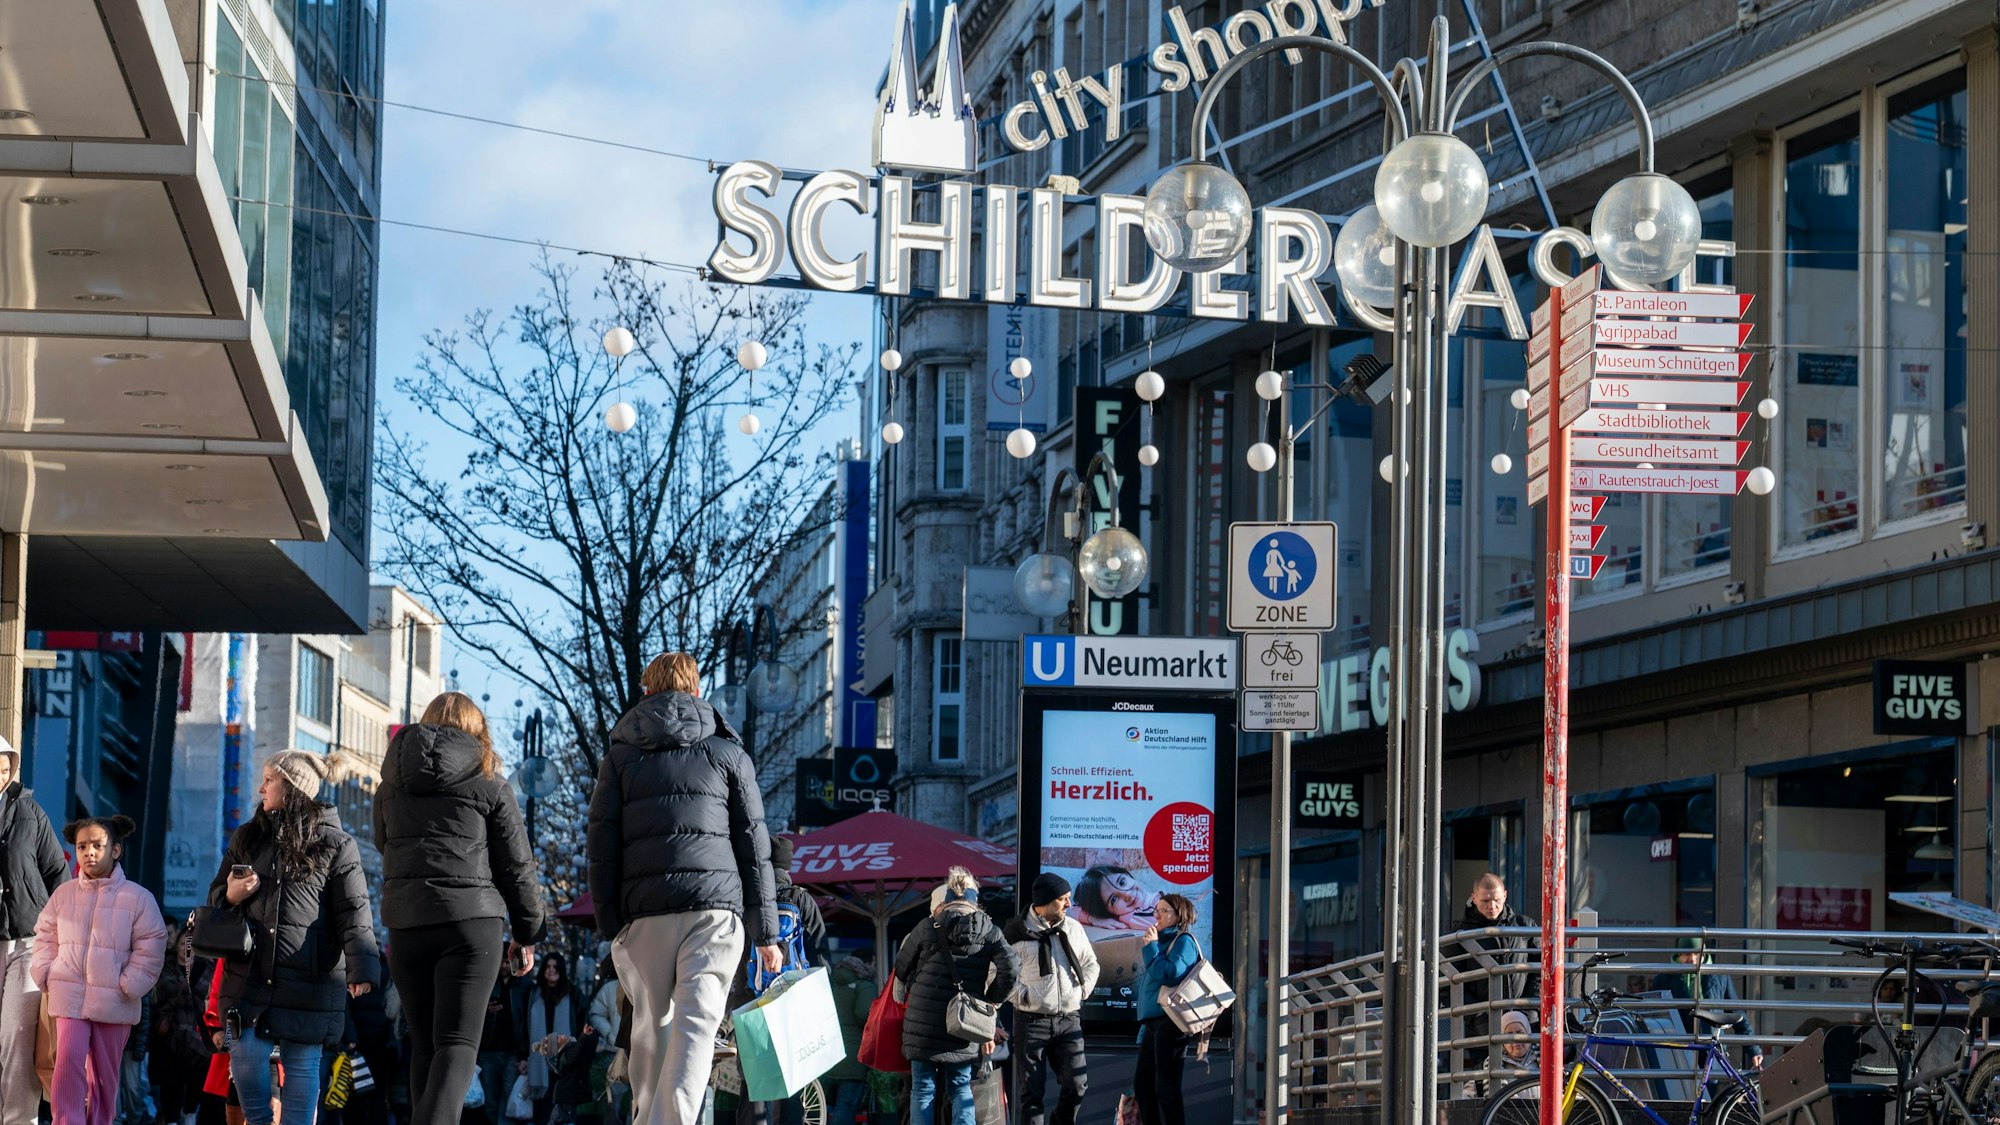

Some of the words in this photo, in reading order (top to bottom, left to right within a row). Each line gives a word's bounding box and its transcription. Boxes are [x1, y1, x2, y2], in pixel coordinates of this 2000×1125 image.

[1004, 62, 1122, 152] city
[1153, 0, 1386, 92] shopp
[1597, 292, 1612, 309] St.
[1616, 296, 1687, 312] Pantaleon
[1597, 325, 1677, 342] Agrippabad
[1005, 304, 1022, 391] ATEMIS
[1597, 355, 1655, 369] Museum
[1658, 355, 1736, 375] Schnütgen
[1599, 383, 1630, 398] VHS
[1598, 413, 1711, 431] Stadtbibliothek
[1597, 443, 1719, 460] Gesundheitsamt
[1599, 473, 1720, 491] Rautenstrauch-Joest
[1571, 503, 1591, 513] WC
[1571, 534, 1590, 542] TAXI
[1575, 560, 1586, 574] U
[1256, 606, 1308, 622] ZONE
[1032, 641, 1066, 682] U
[1083, 647, 1228, 679] Neumarkt
[1270, 668, 1294, 682] frei
[1893, 674, 1954, 697] FIVE
[1112, 701, 1154, 712] JCDecaux
[1249, 709, 1269, 717] Sonn-
[1283, 709, 1310, 718] feiertags
[1885, 697, 1962, 721] GUYS
[1264, 717, 1296, 725] ganztägig
[1144, 727, 1169, 735] Aktion
[1144, 735, 1190, 743] Deutschland
[1191, 736, 1207, 744] Hilft
[1051, 766, 1089, 776] Schnell.
[1090, 767, 1134, 776] Effizient.
[837, 789, 891, 803] IQOS
[1051, 780, 1154, 801] Herzlich.
[1305, 782, 1354, 800] FIVE
[1299, 800, 1360, 818] GUYS
[1050, 815, 1090, 823] Gemeinsame
[1090, 816, 1117, 824] Nothilfe,
[1096, 823, 1120, 831] kommt.
[1050, 833, 1140, 841] Aktion-Deutschland-Hilft.de
[793, 842, 894, 859] FIVE
[1651, 838, 1673, 858] OPEN
[1184, 853, 1210, 863] Jetzt
[1162, 863, 1209, 875] spenden!
